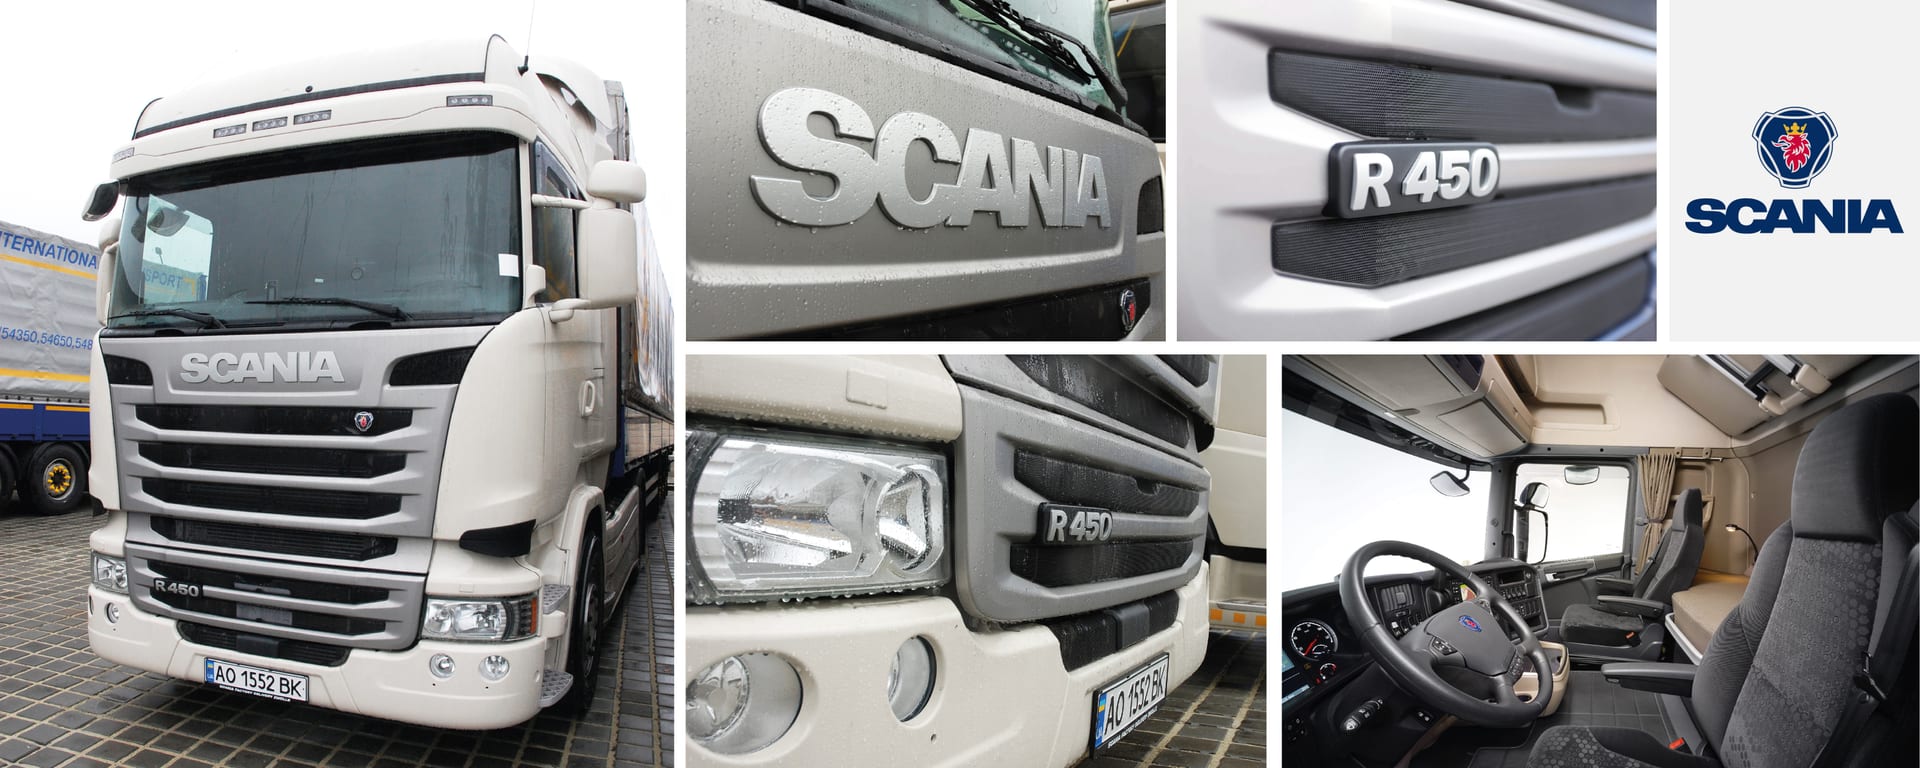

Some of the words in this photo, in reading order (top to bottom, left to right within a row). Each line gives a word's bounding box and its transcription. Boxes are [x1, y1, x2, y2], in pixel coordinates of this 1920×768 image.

[749, 87, 1111, 229] SCANIA
[1351, 152, 1394, 211] R
[1401, 148, 1499, 203] 450
[1685, 197, 1904, 234] SCANIA
[0, 230, 97, 270] TERNATIONA
[144, 267, 184, 289] SPORT
[0, 326, 93, 350] 54350,54650,548
[180, 351, 345, 383] SCANIA
[1047, 509, 1068, 542] R
[1069, 511, 1113, 541] 450
[155, 580, 167, 592] R
[167, 582, 199, 597] 450
[215, 665, 236, 684] AO
[241, 670, 275, 692] 1552
[279, 677, 302, 697] BK
[1104, 690, 1125, 736] AO
[1128, 674, 1151, 718] 1552
[1151, 663, 1166, 702] BK
